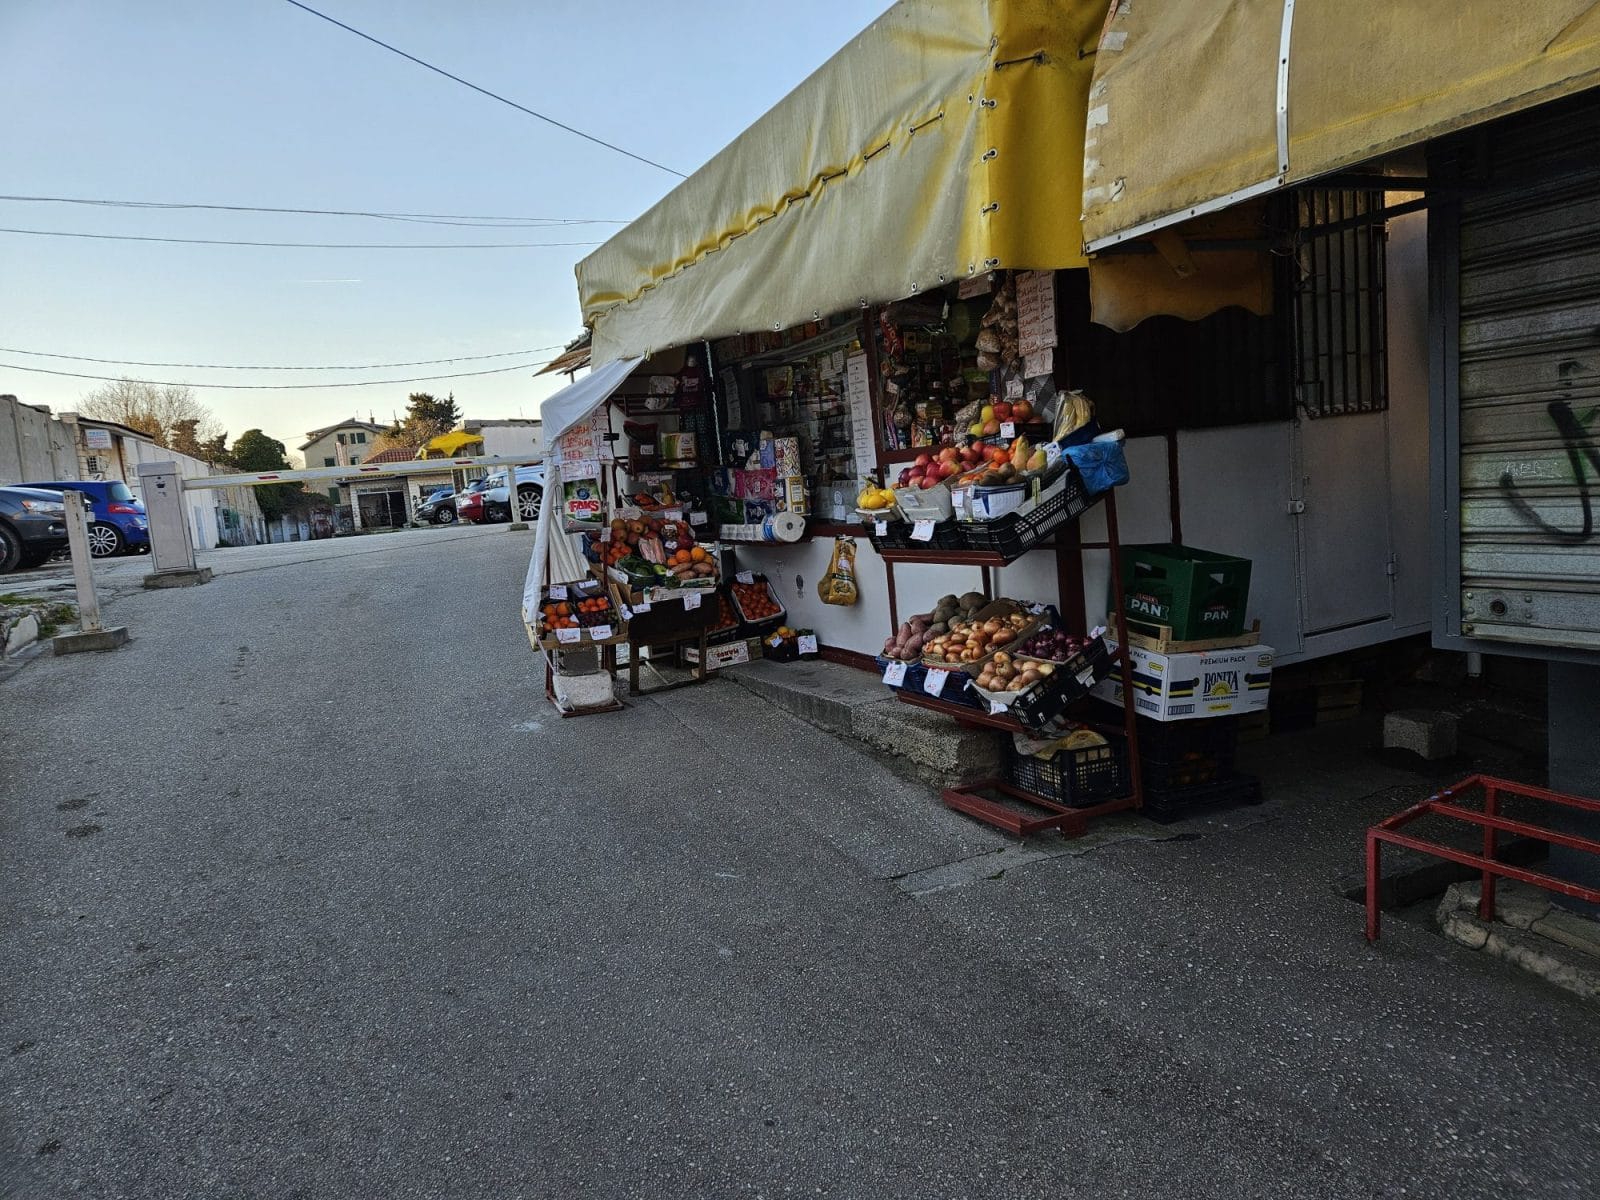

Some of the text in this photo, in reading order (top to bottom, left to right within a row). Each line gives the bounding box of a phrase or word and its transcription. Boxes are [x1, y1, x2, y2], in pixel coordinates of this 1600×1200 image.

[569, 501, 599, 513] FAKS
[1131, 598, 1161, 617] PAN
[1203, 609, 1229, 621] PAN
[1200, 655, 1246, 665] PREMIUM PACK
[1203, 670, 1239, 694] BONITA
